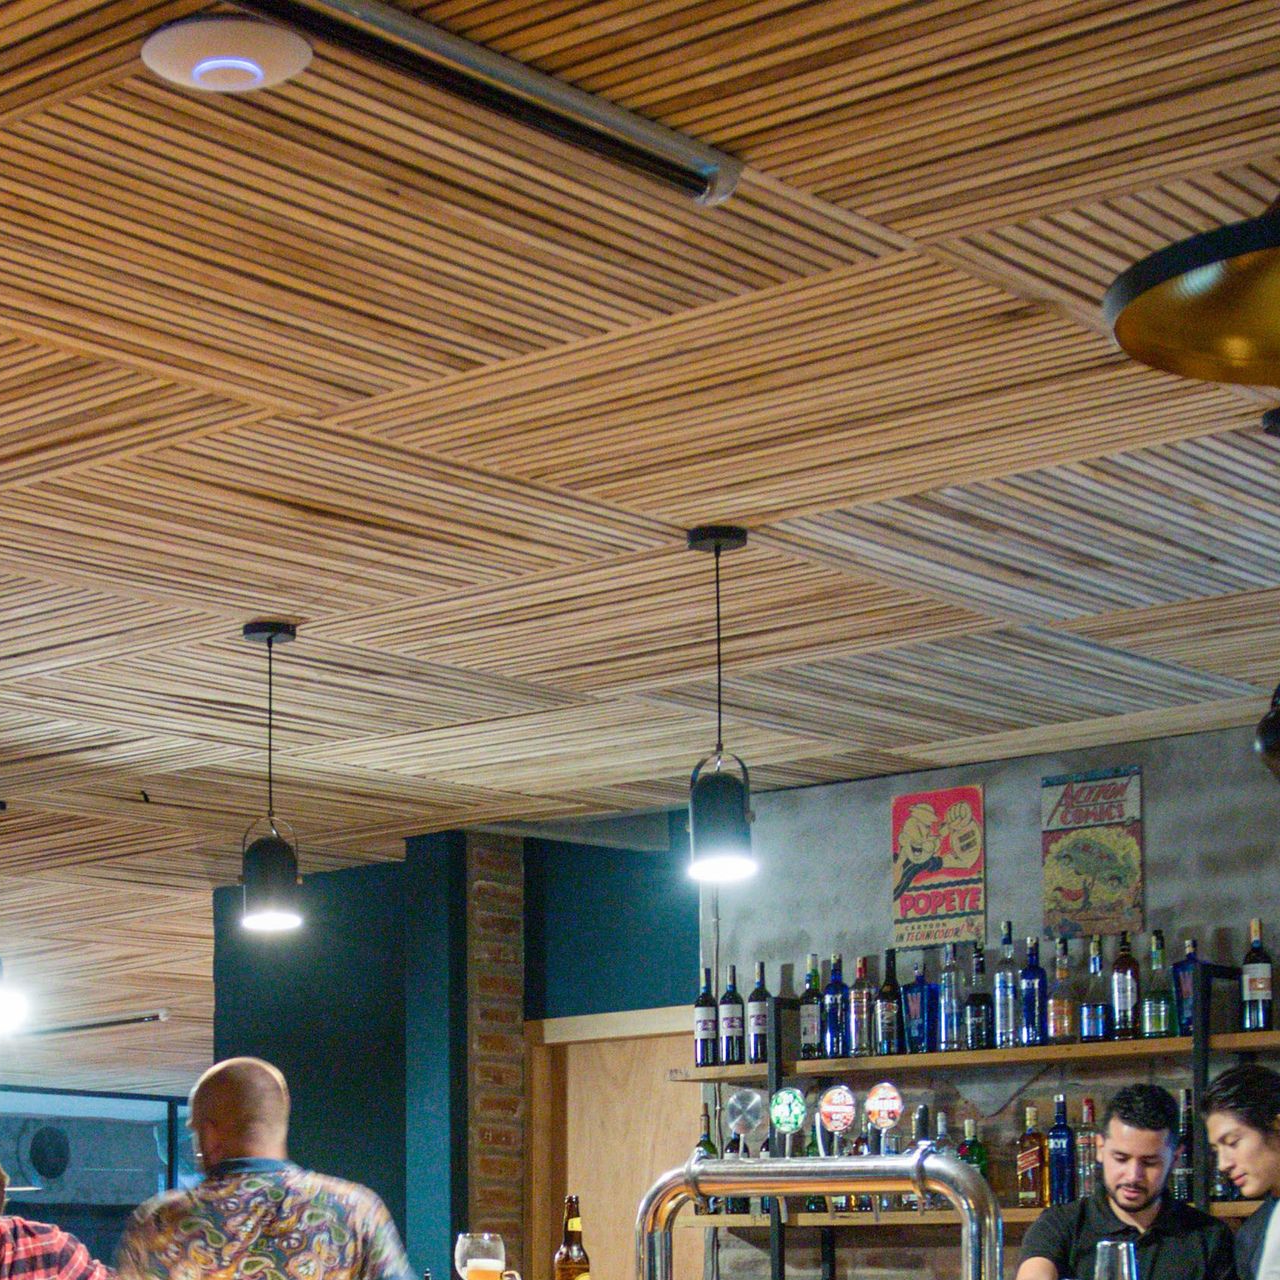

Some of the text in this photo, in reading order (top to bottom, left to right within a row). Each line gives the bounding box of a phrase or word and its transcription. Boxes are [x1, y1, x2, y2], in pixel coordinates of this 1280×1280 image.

[1048, 777, 1131, 826] ACTION
[1059, 801, 1125, 825] COMICS
[899, 886, 982, 918] POPEYE
